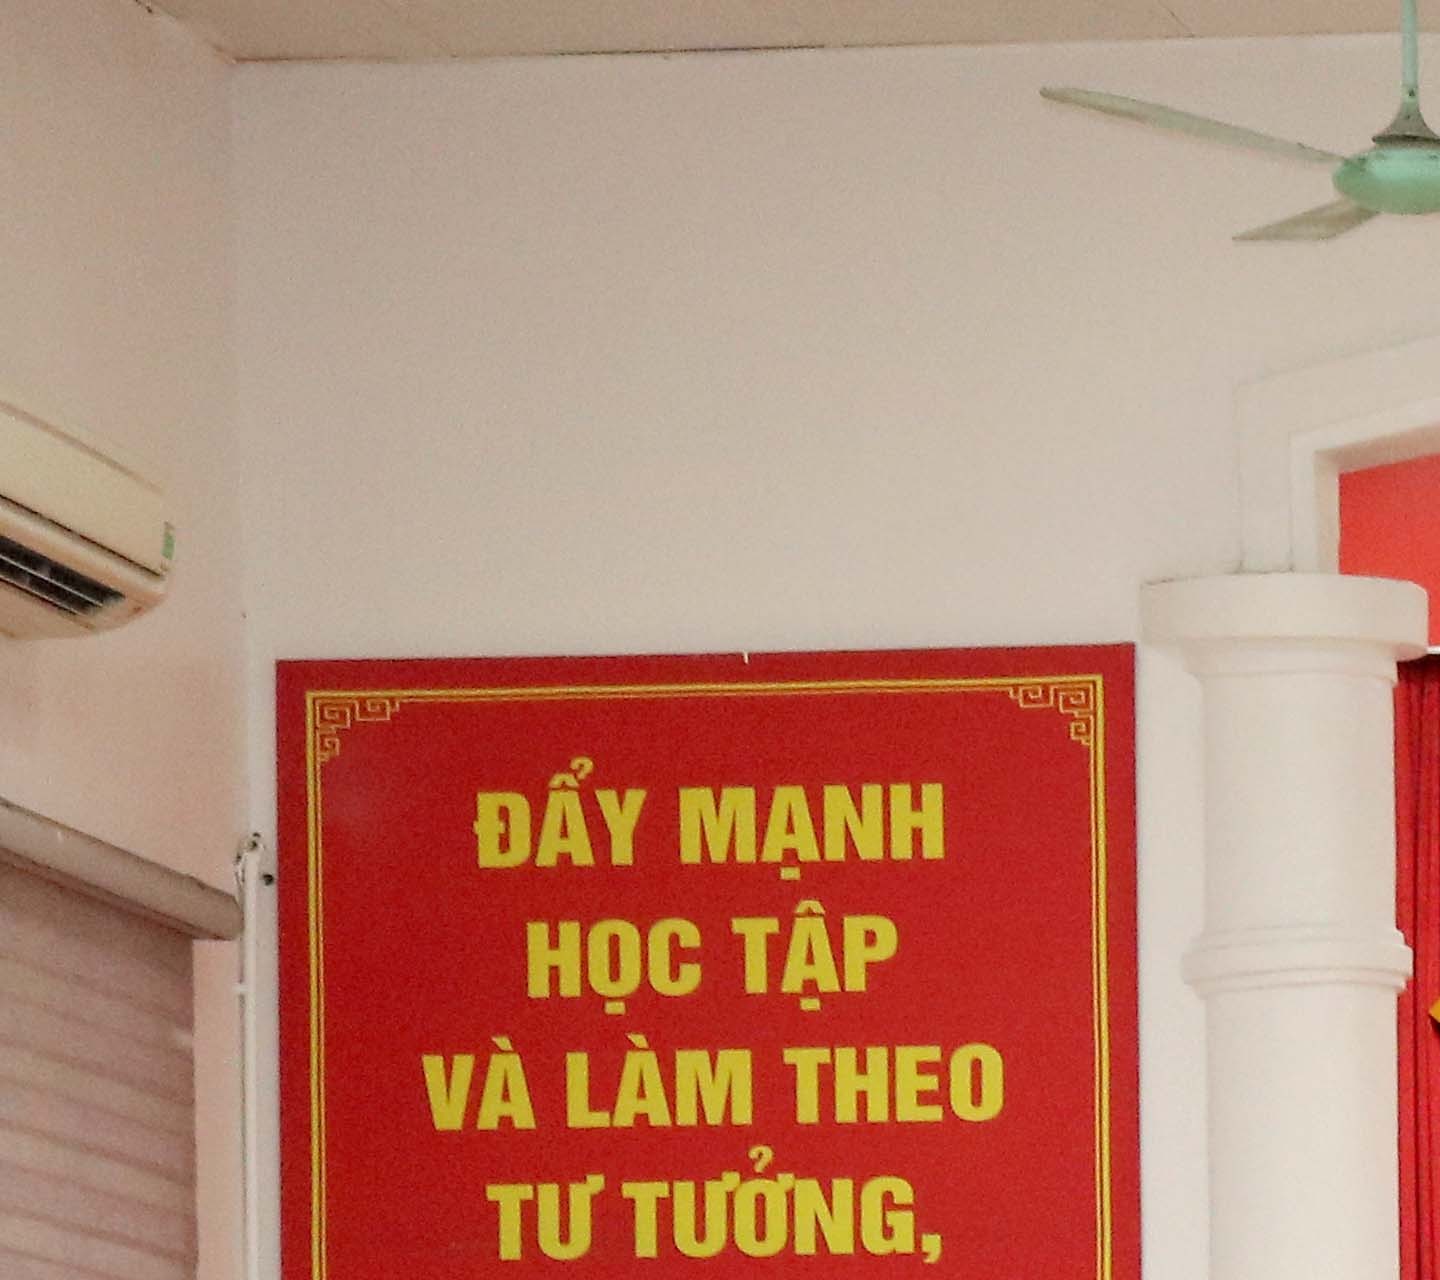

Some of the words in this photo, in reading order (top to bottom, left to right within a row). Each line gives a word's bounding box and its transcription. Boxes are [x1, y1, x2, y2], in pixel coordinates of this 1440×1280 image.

[474, 759, 645, 866] ĐẨY
[680, 784, 943, 879] MẠNH
[528, 919, 700, 1013] HỌC
[733, 901, 897, 1010] TẬP
[423, 1038, 535, 1129] VÀ
[567, 1035, 752, 1127] LÀM
[784, 1044, 1003, 1123] THEO
[487, 1175, 604, 1259] TƯ
[623, 1146, 941, 1262] TƯỞNG,
